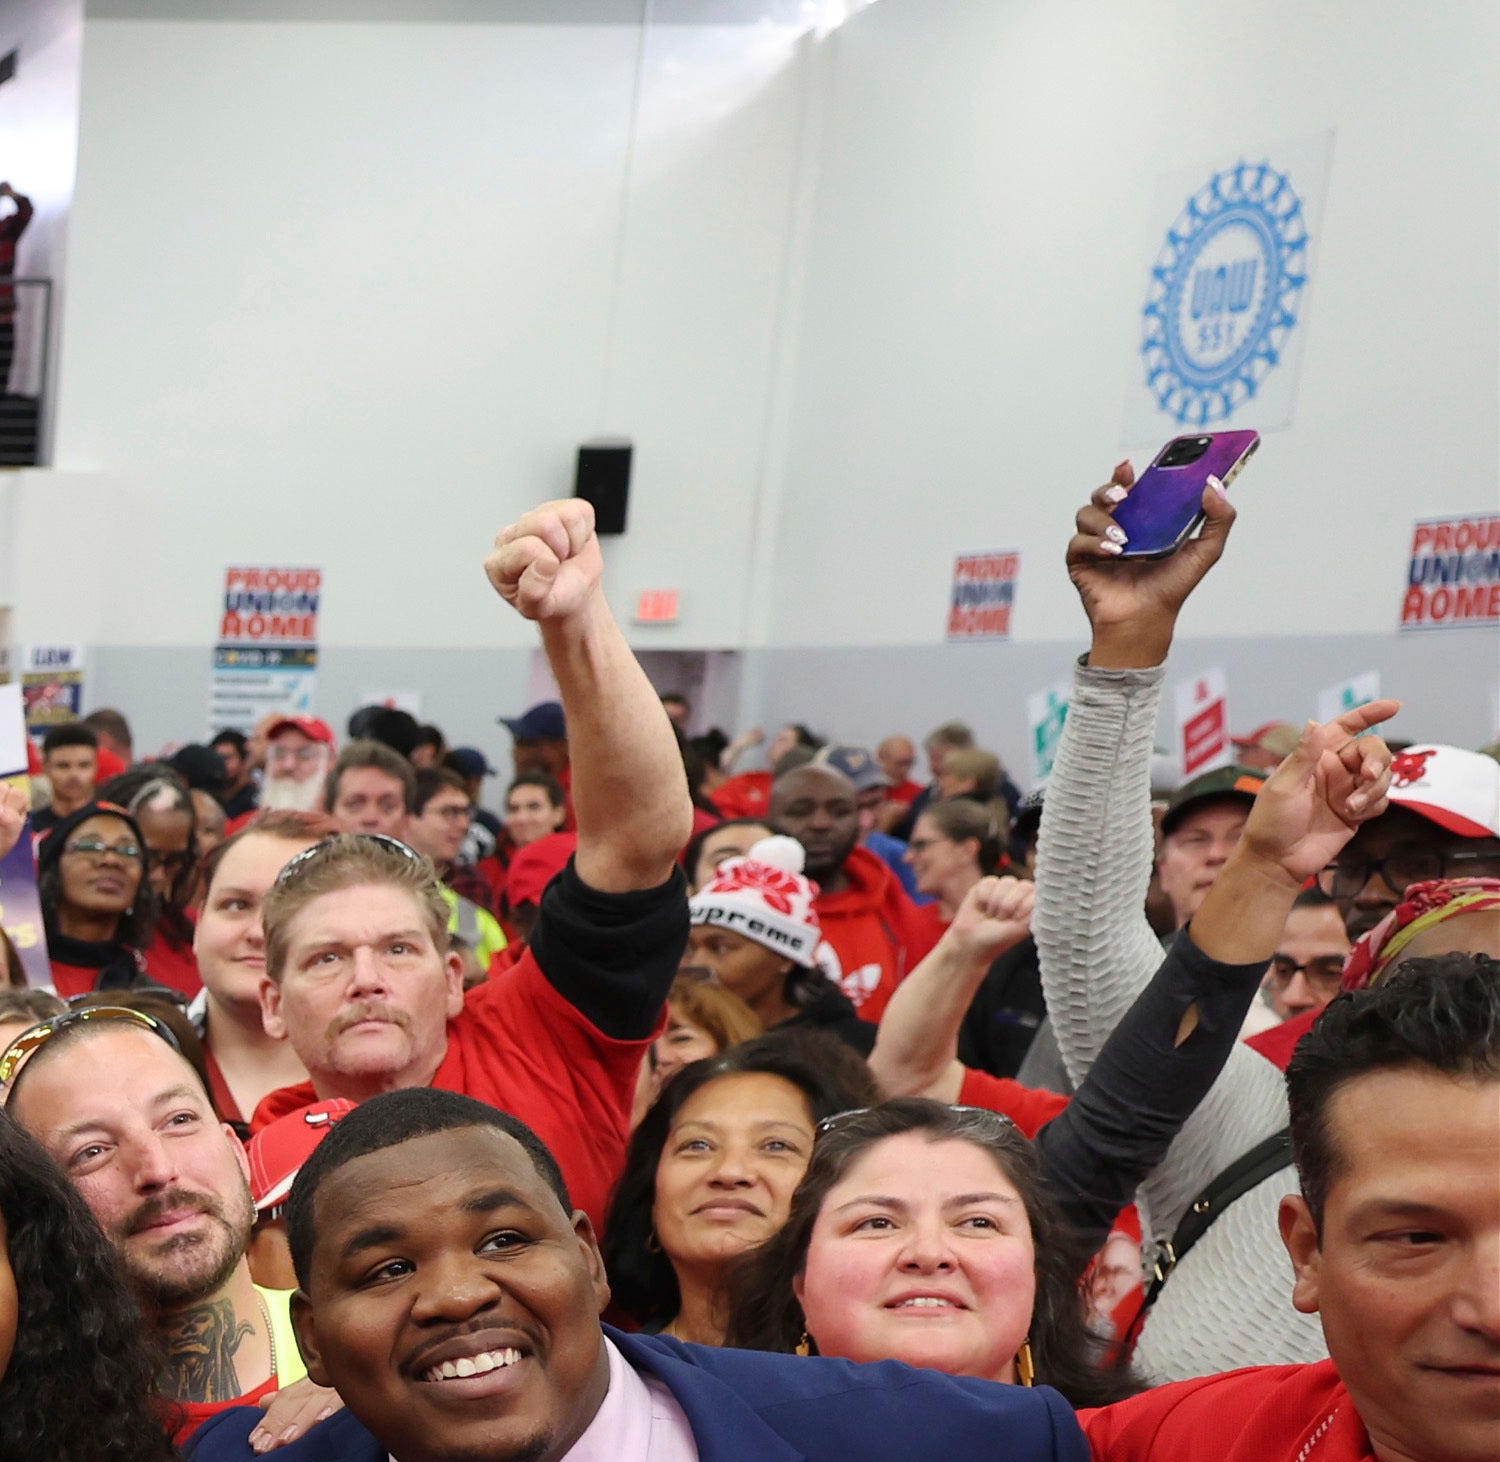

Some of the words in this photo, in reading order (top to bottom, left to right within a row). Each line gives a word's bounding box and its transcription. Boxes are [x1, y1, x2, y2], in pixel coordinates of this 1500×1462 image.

[226, 569, 321, 592] PROUD
[225, 592, 320, 613] UNION
[690, 905, 804, 950] upreme
